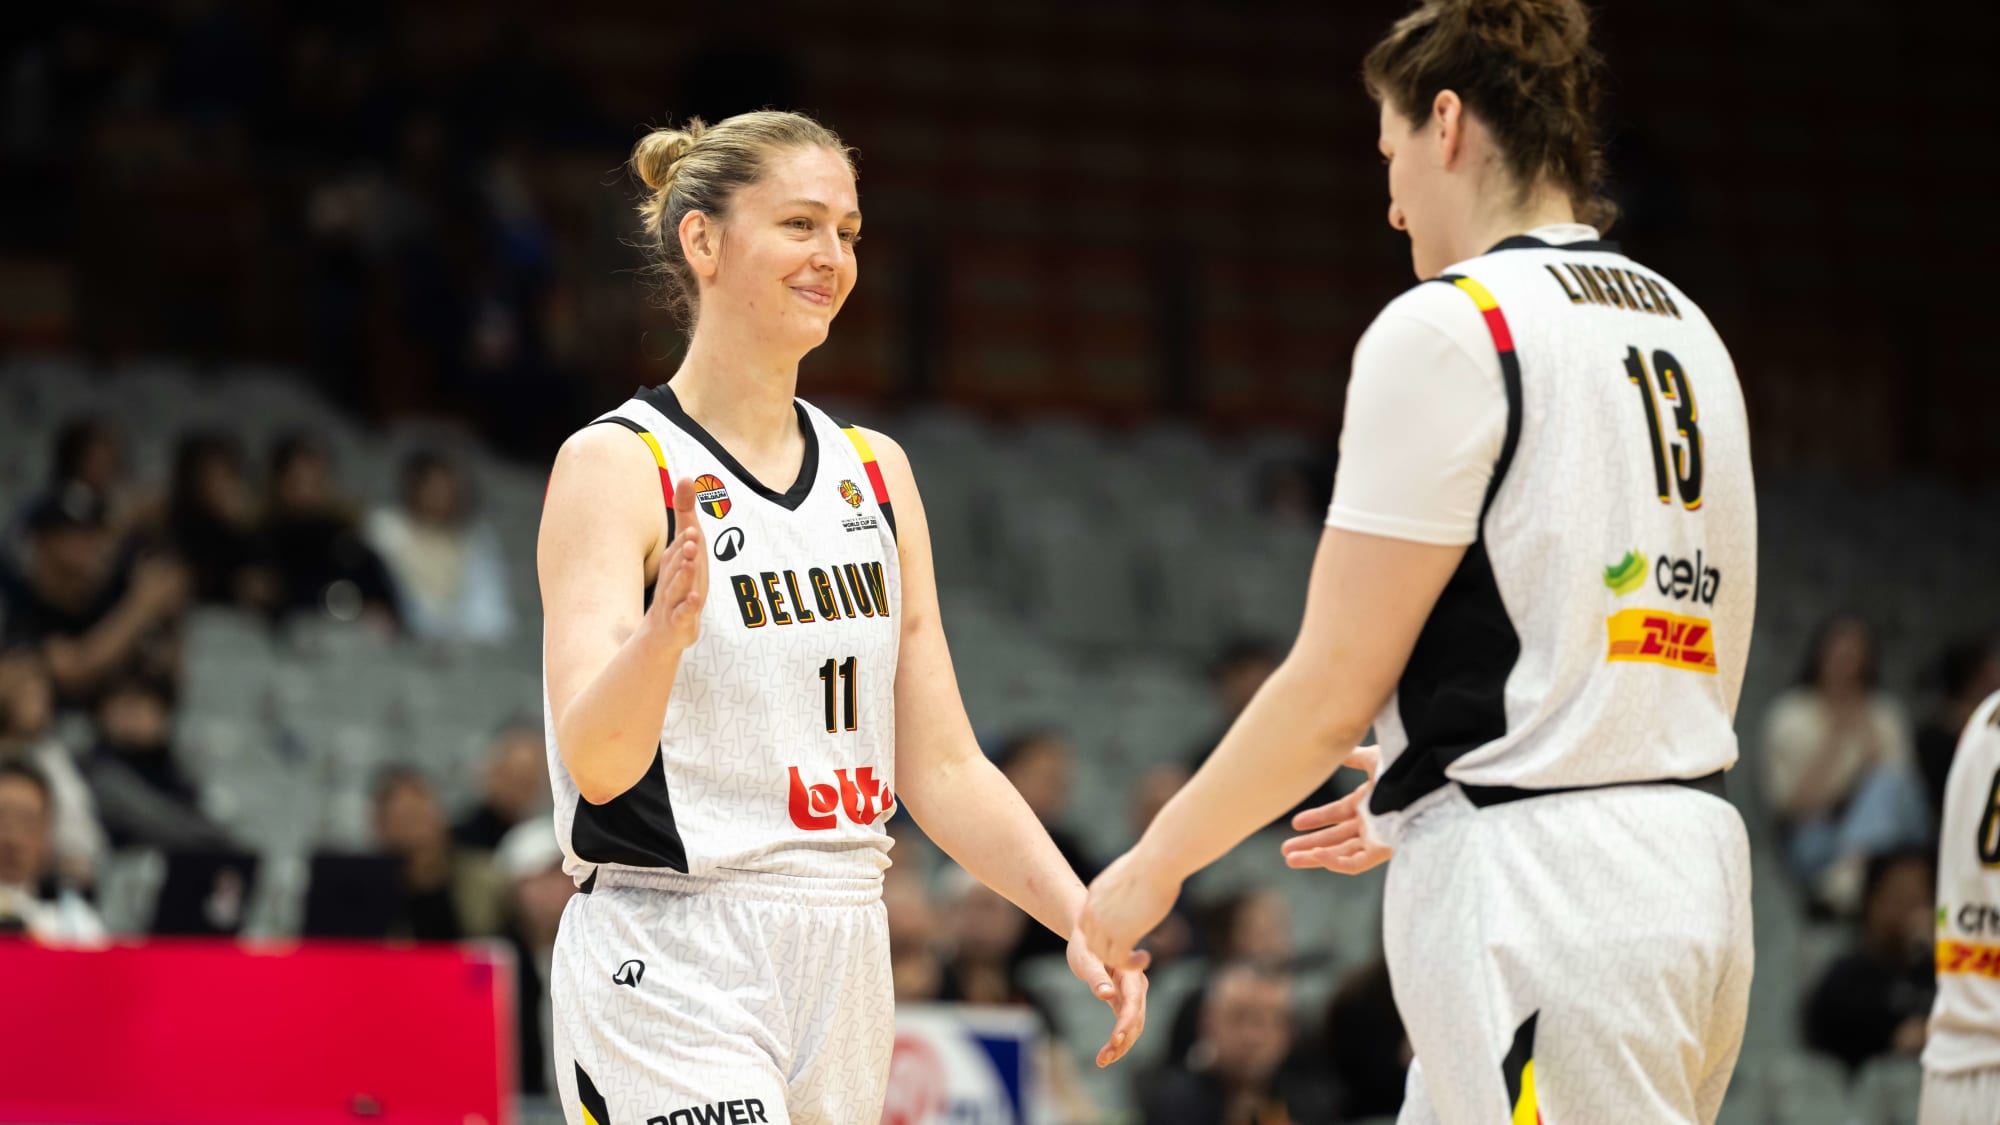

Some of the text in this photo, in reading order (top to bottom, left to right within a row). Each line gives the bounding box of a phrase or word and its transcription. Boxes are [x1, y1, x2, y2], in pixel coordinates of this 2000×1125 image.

[1622, 345, 1704, 511] 13
[730, 561, 889, 628] BELGIUM
[819, 656, 857, 733] 11
